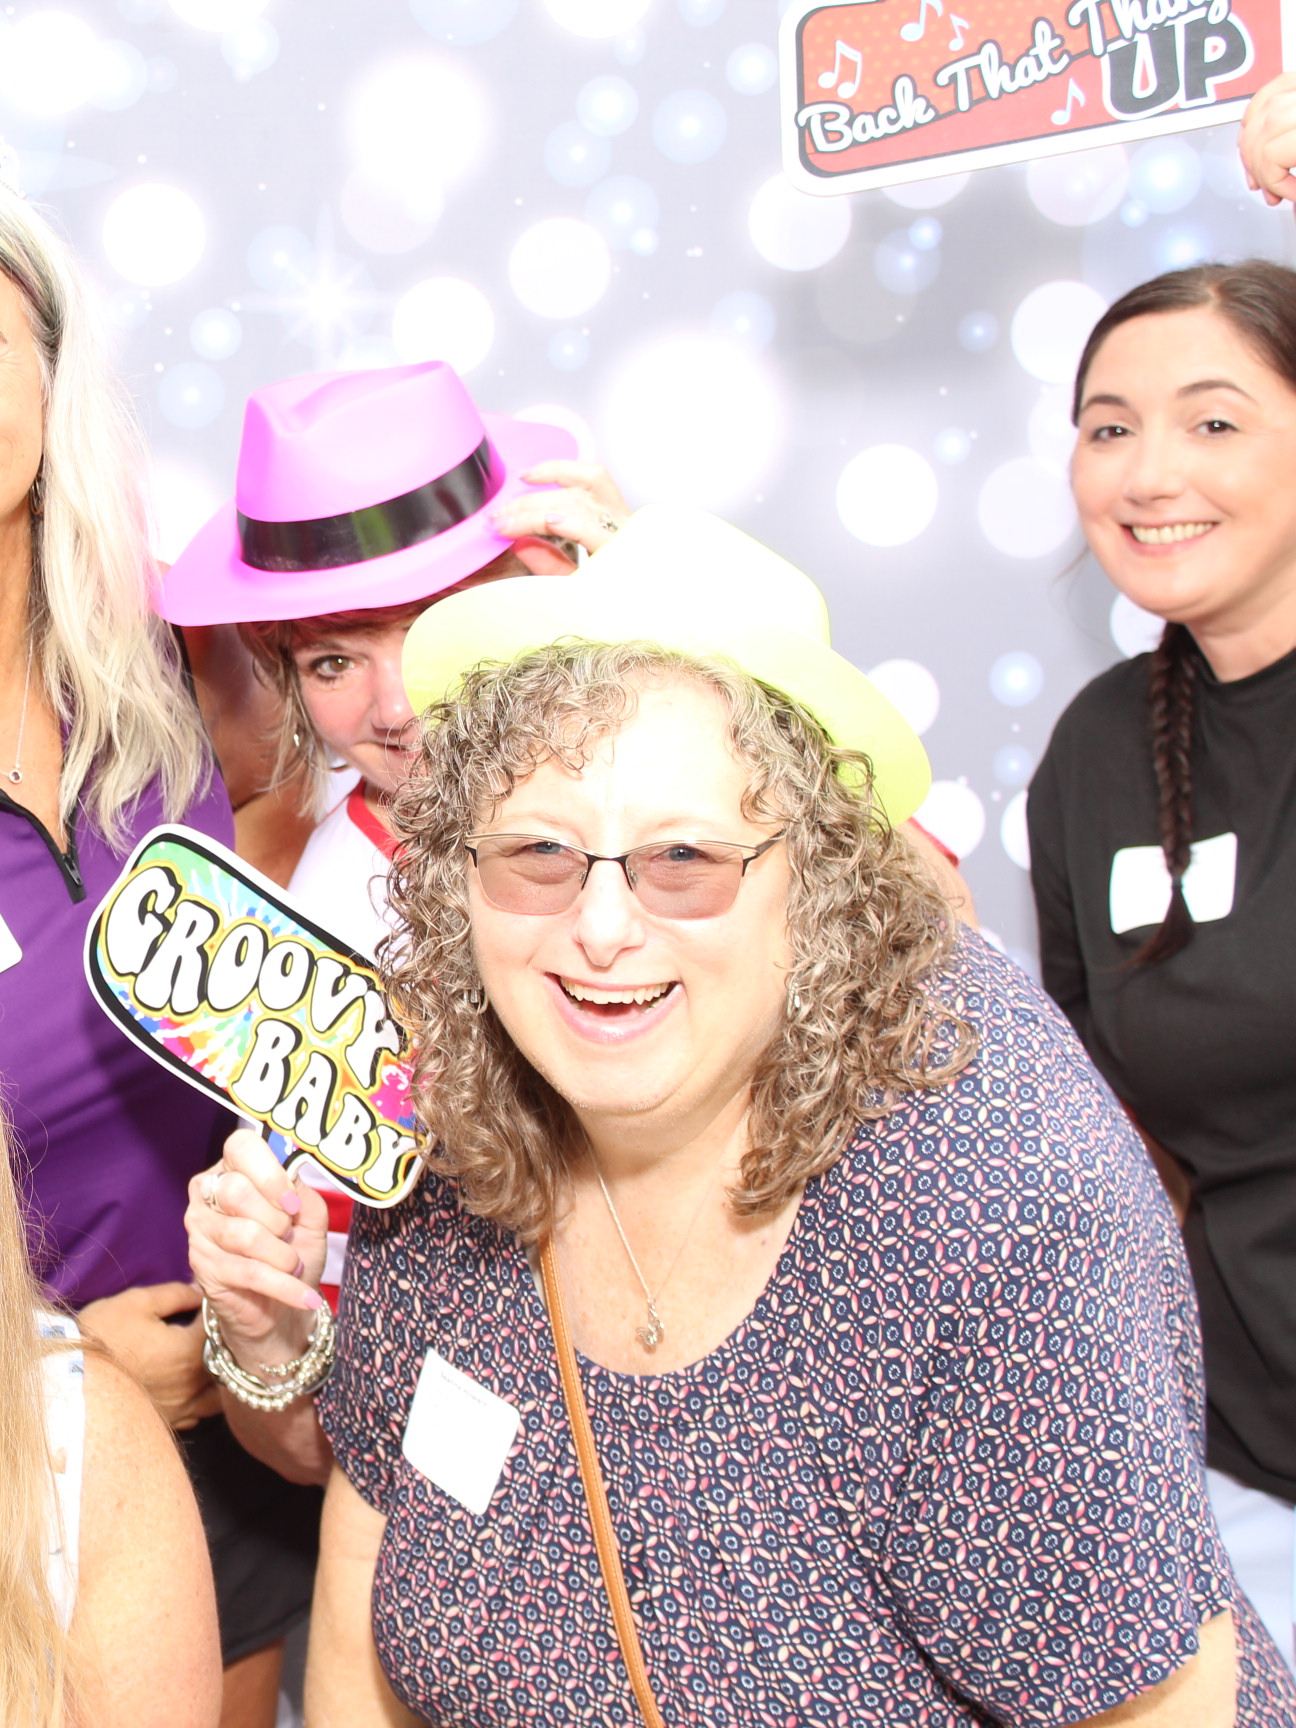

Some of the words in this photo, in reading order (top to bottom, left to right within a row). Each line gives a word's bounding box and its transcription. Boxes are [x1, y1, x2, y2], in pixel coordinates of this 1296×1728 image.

[798, 76, 934, 152] Back
[936, 19, 1070, 112] That
[1104, 14, 1250, 117] UP
[106, 866, 401, 1089] GROOVY
[232, 1018, 417, 1193] BABY
